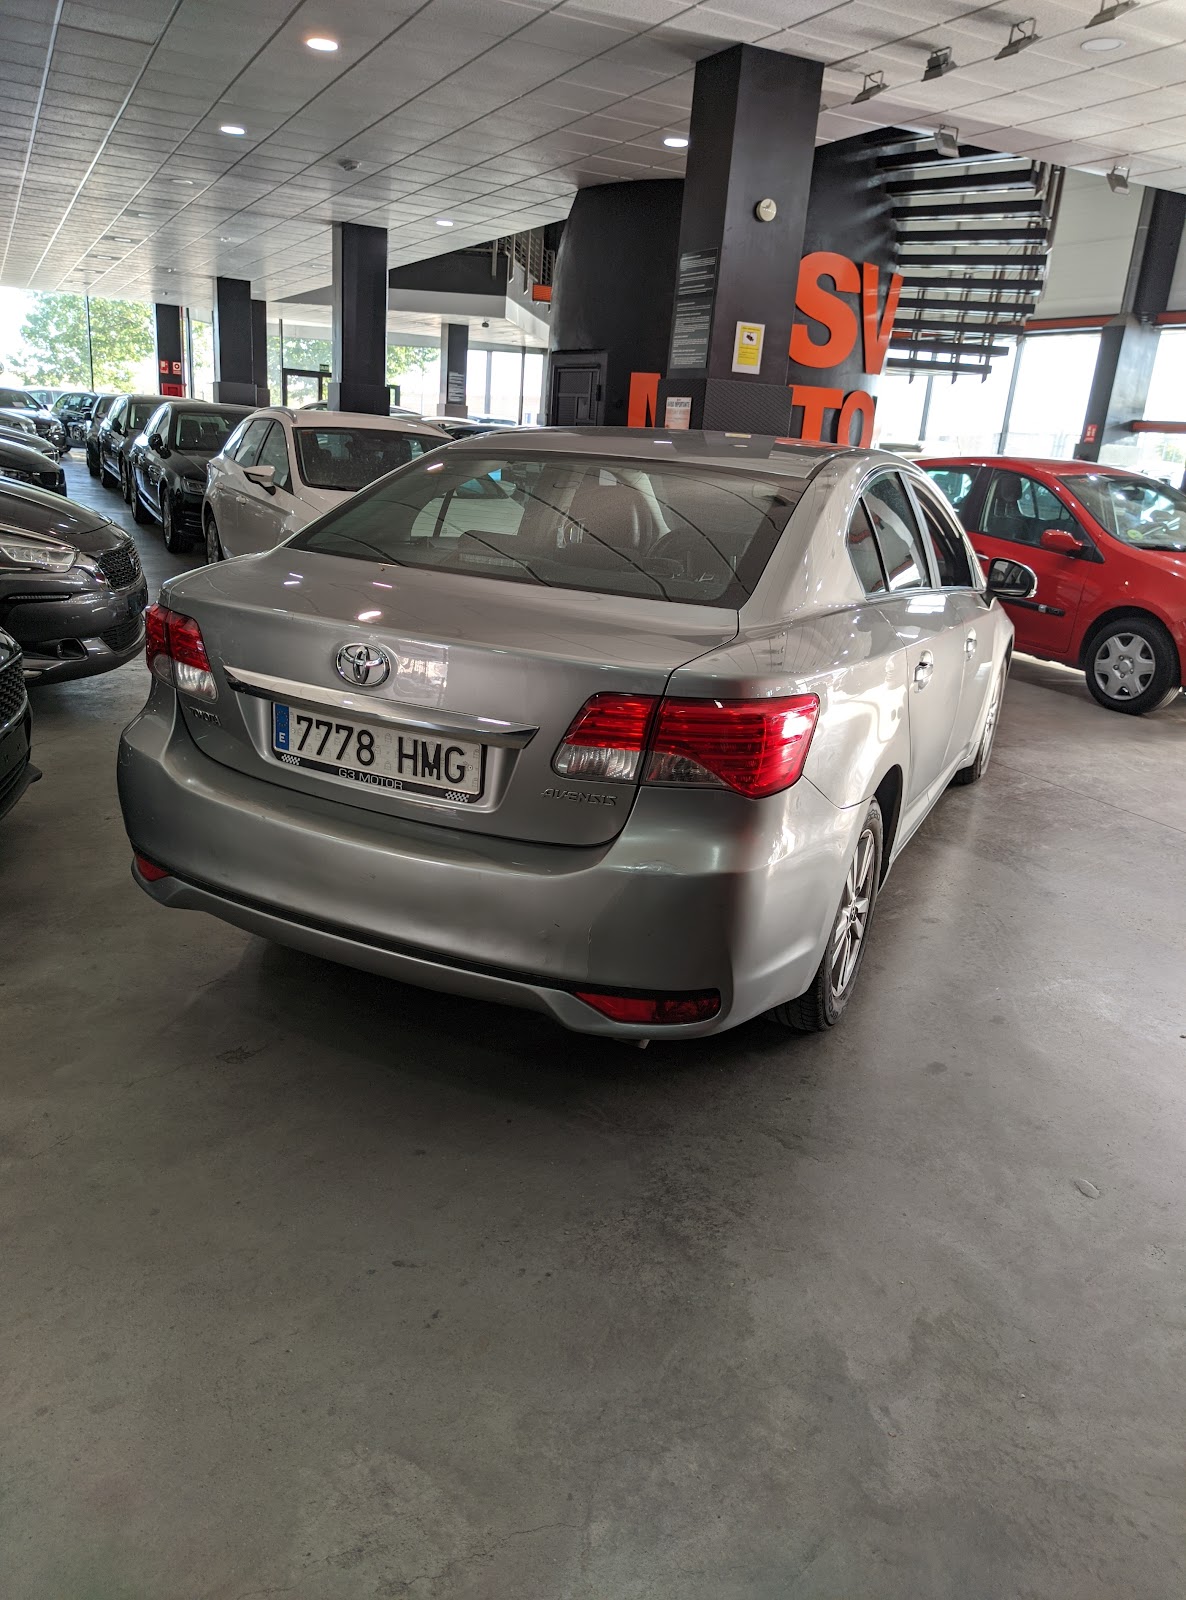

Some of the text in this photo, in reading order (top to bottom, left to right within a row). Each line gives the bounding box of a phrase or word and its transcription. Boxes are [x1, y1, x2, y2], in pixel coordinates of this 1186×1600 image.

[279, 714, 466, 784] E 7778 HMG
[338, 768, 403, 790] G3 MOTOR
[540, 788, 618, 806] AVENSIS
